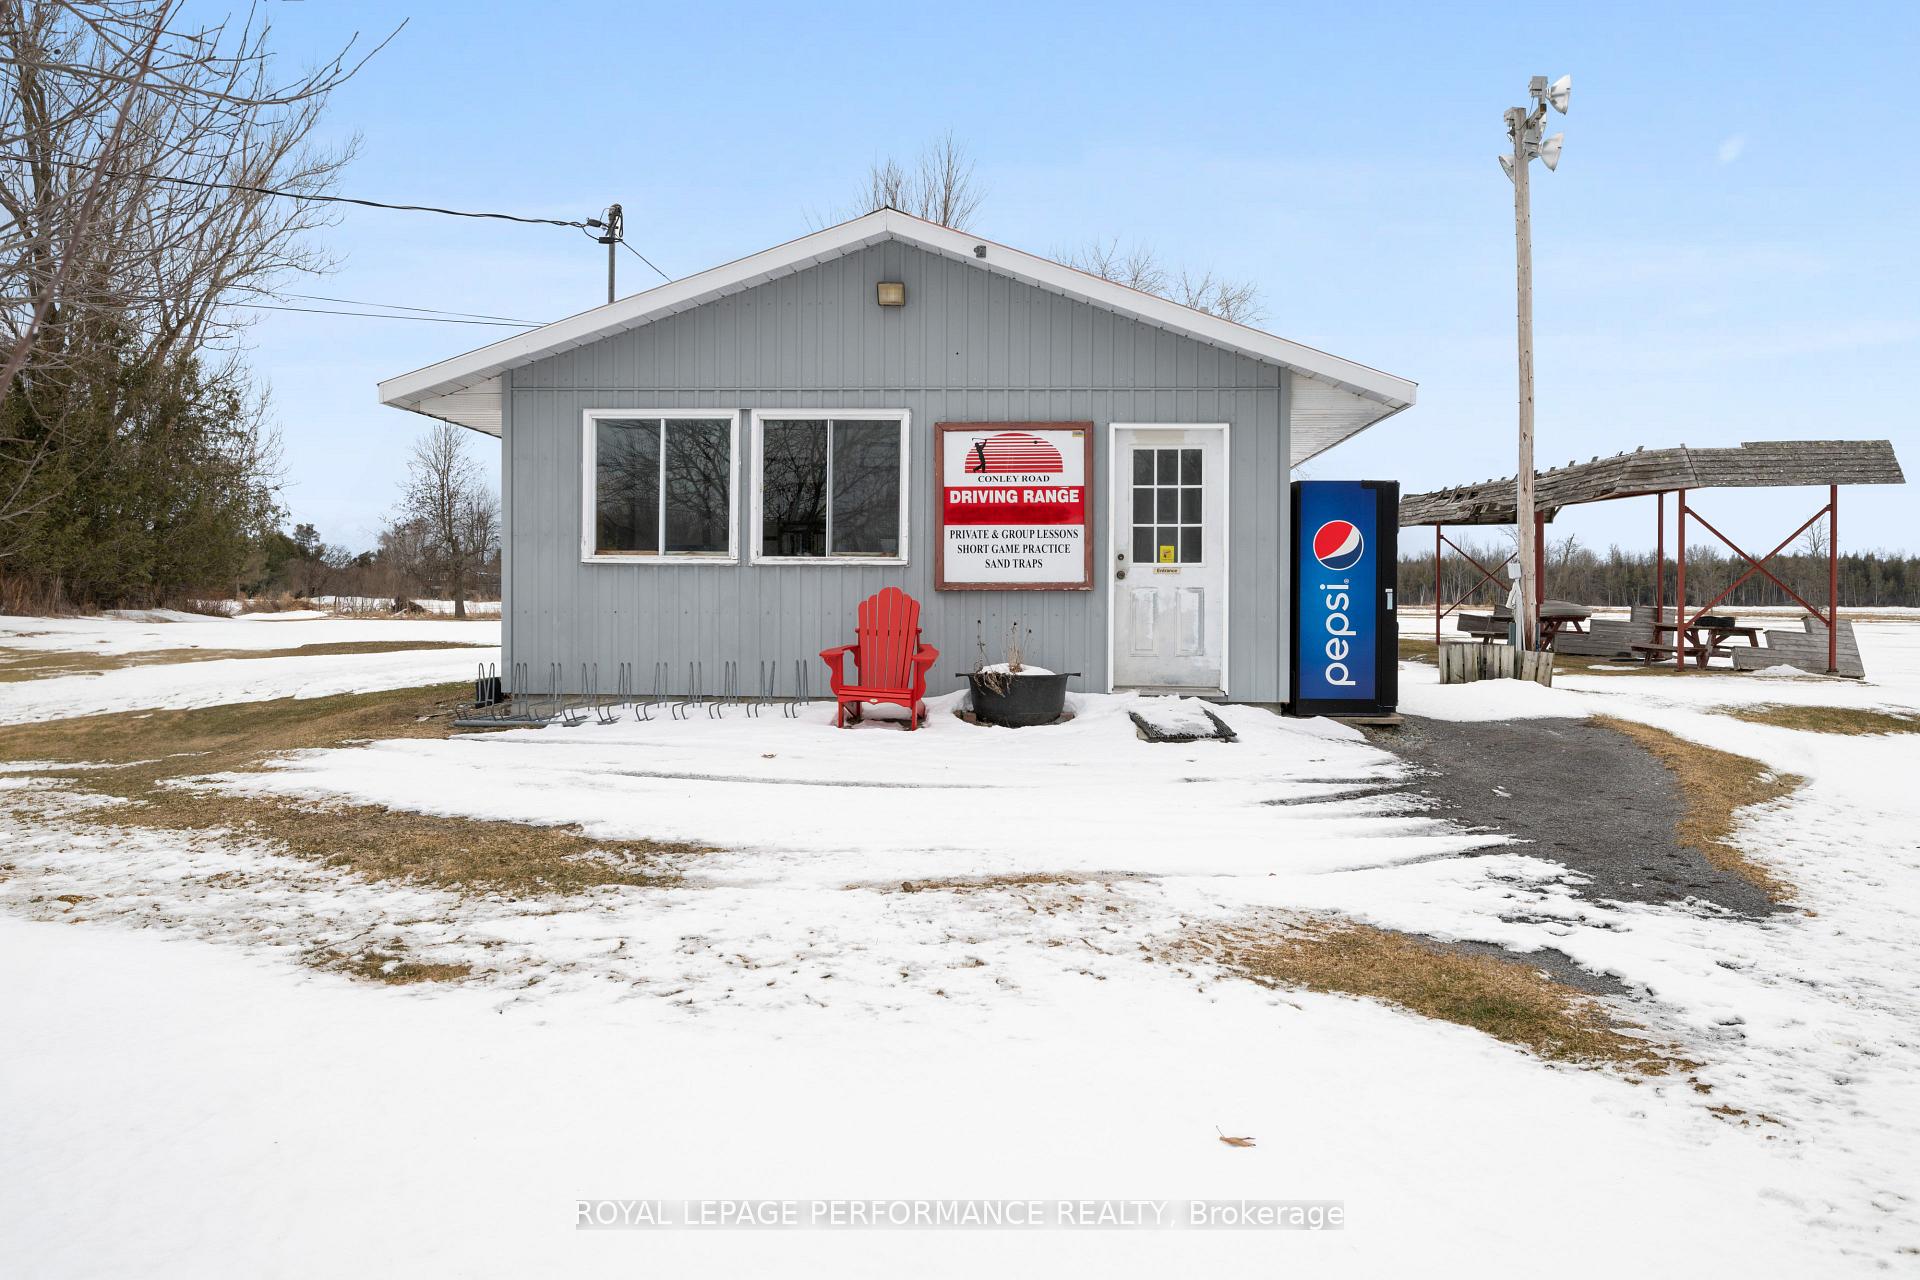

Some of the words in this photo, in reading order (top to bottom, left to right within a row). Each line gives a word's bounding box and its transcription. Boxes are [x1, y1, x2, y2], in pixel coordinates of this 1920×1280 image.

[977, 475, 1018, 483] CONLEY
[1021, 475, 1050, 483] ROAD
[950, 490, 1018, 504] DRIVING
[1023, 489, 1080, 503] RANGE
[950, 529, 990, 539] PRIVATE
[991, 529, 999, 539] &
[1001, 529, 1036, 539] GROUP
[1037, 529, 1079, 539] LESSONS
[957, 544, 990, 554] SHORT
[991, 544, 1020, 554] GAME
[1022, 544, 1071, 554] PRACTICE
[985, 559, 1011, 569] SAND
[1012, 559, 1043, 569] TRAPS
[1319, 583, 1357, 686] pepsi
